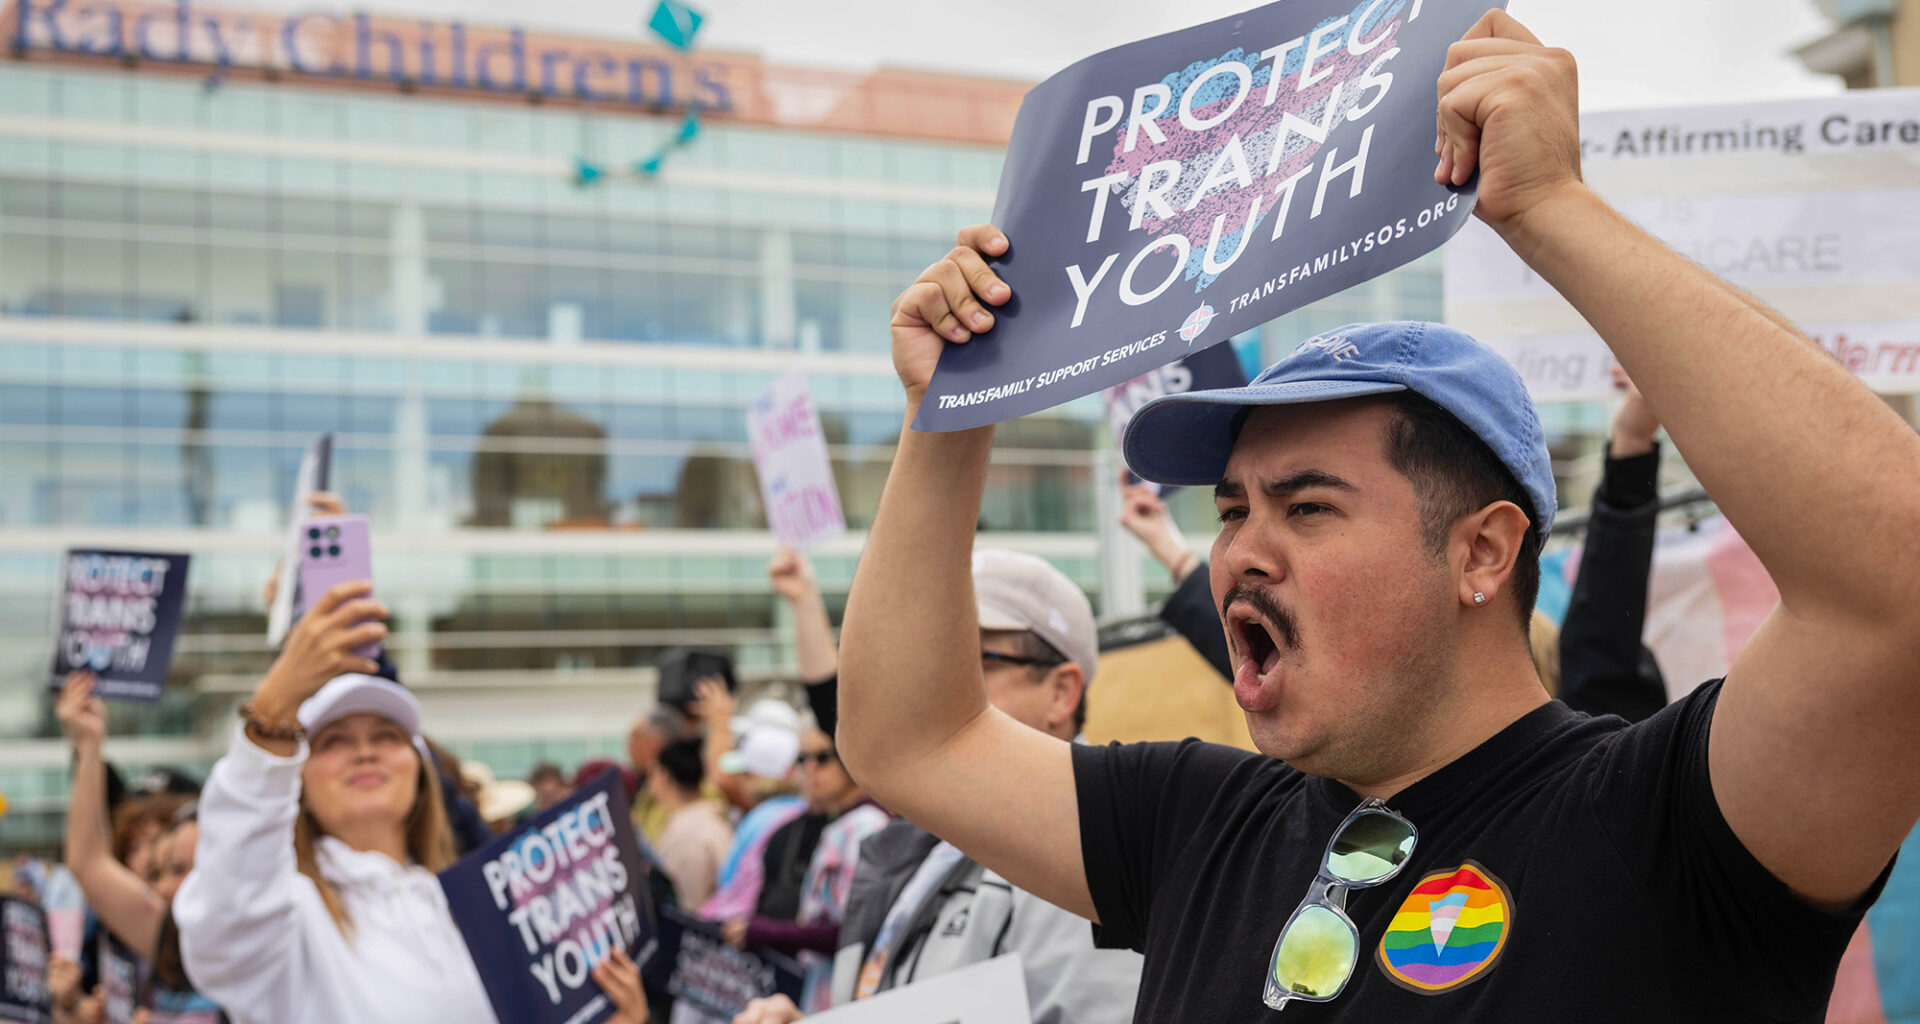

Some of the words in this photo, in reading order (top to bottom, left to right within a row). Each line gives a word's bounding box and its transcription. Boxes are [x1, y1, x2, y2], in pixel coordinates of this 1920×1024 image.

[14, 0, 256, 93] Rady
[281, 12, 733, 113] Childrens
[1081, 47, 1401, 243] TRANS
[1820, 114, 1920, 146] Care
[1065, 124, 1375, 328] YOUTH
[1229, 193, 1459, 314] TRANSFAMILYSOS.ORG
[939, 377, 1035, 409] TRANSFAMILY
[1036, 356, 1100, 388] SUPPORT
[1101, 330, 1167, 366] SERVICES
[482, 791, 615, 911] PROTECT
[508, 845, 628, 955] TRANS
[530, 893, 641, 1005] YOUTH
